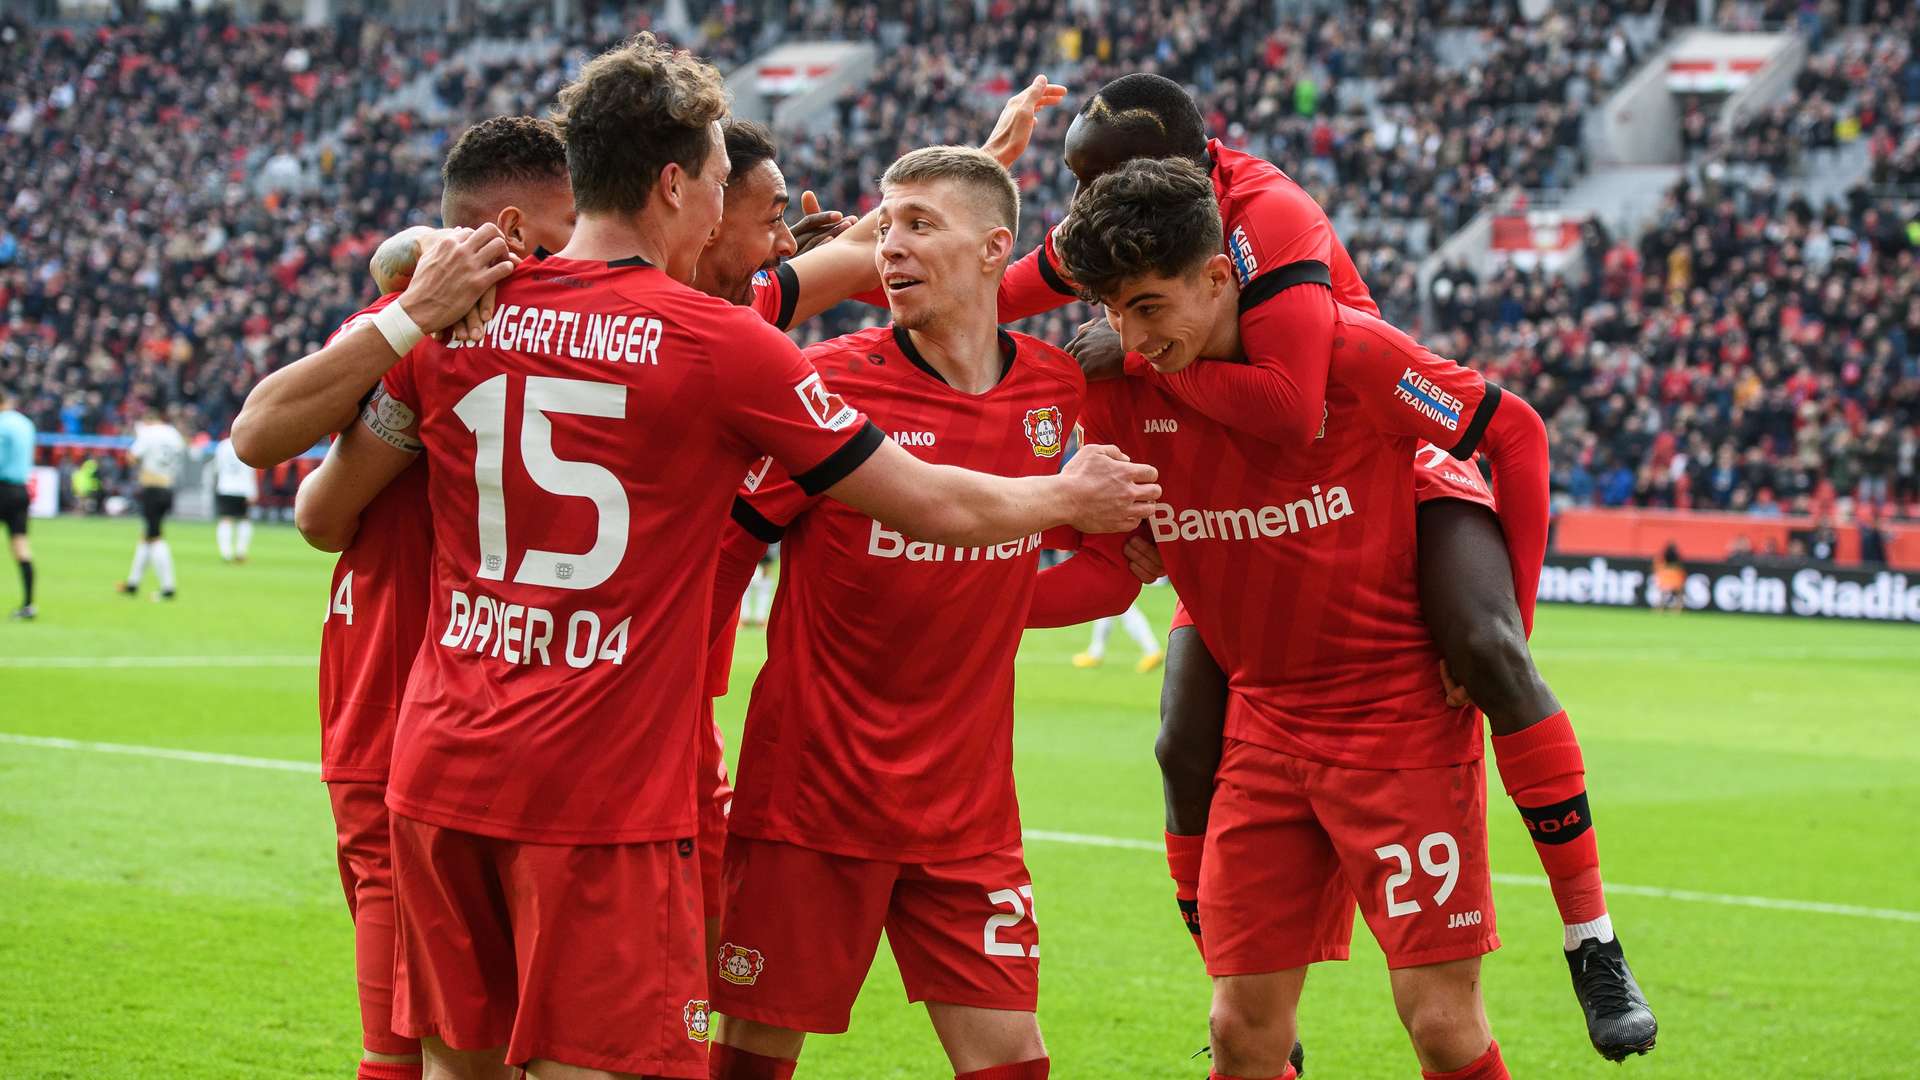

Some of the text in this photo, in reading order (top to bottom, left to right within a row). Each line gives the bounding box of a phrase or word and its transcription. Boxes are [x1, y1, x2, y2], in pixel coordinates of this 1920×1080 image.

[446, 303, 663, 366] MGARTLINGER
[1393, 384, 1458, 432] TRAINING
[1401, 367, 1464, 416] KIESER
[892, 431, 936, 447] JAKO
[1143, 418, 1178, 434] JAKO
[452, 373, 630, 590] 15
[1150, 484, 1354, 543] Barmenia
[325, 569, 354, 626] 4
[1537, 556, 1643, 605] mehr
[1713, 565, 1787, 614] ein
[440, 589, 632, 669] BAYER 04
[1374, 831, 1460, 919] 29
[1447, 910, 1482, 929] JAKO
